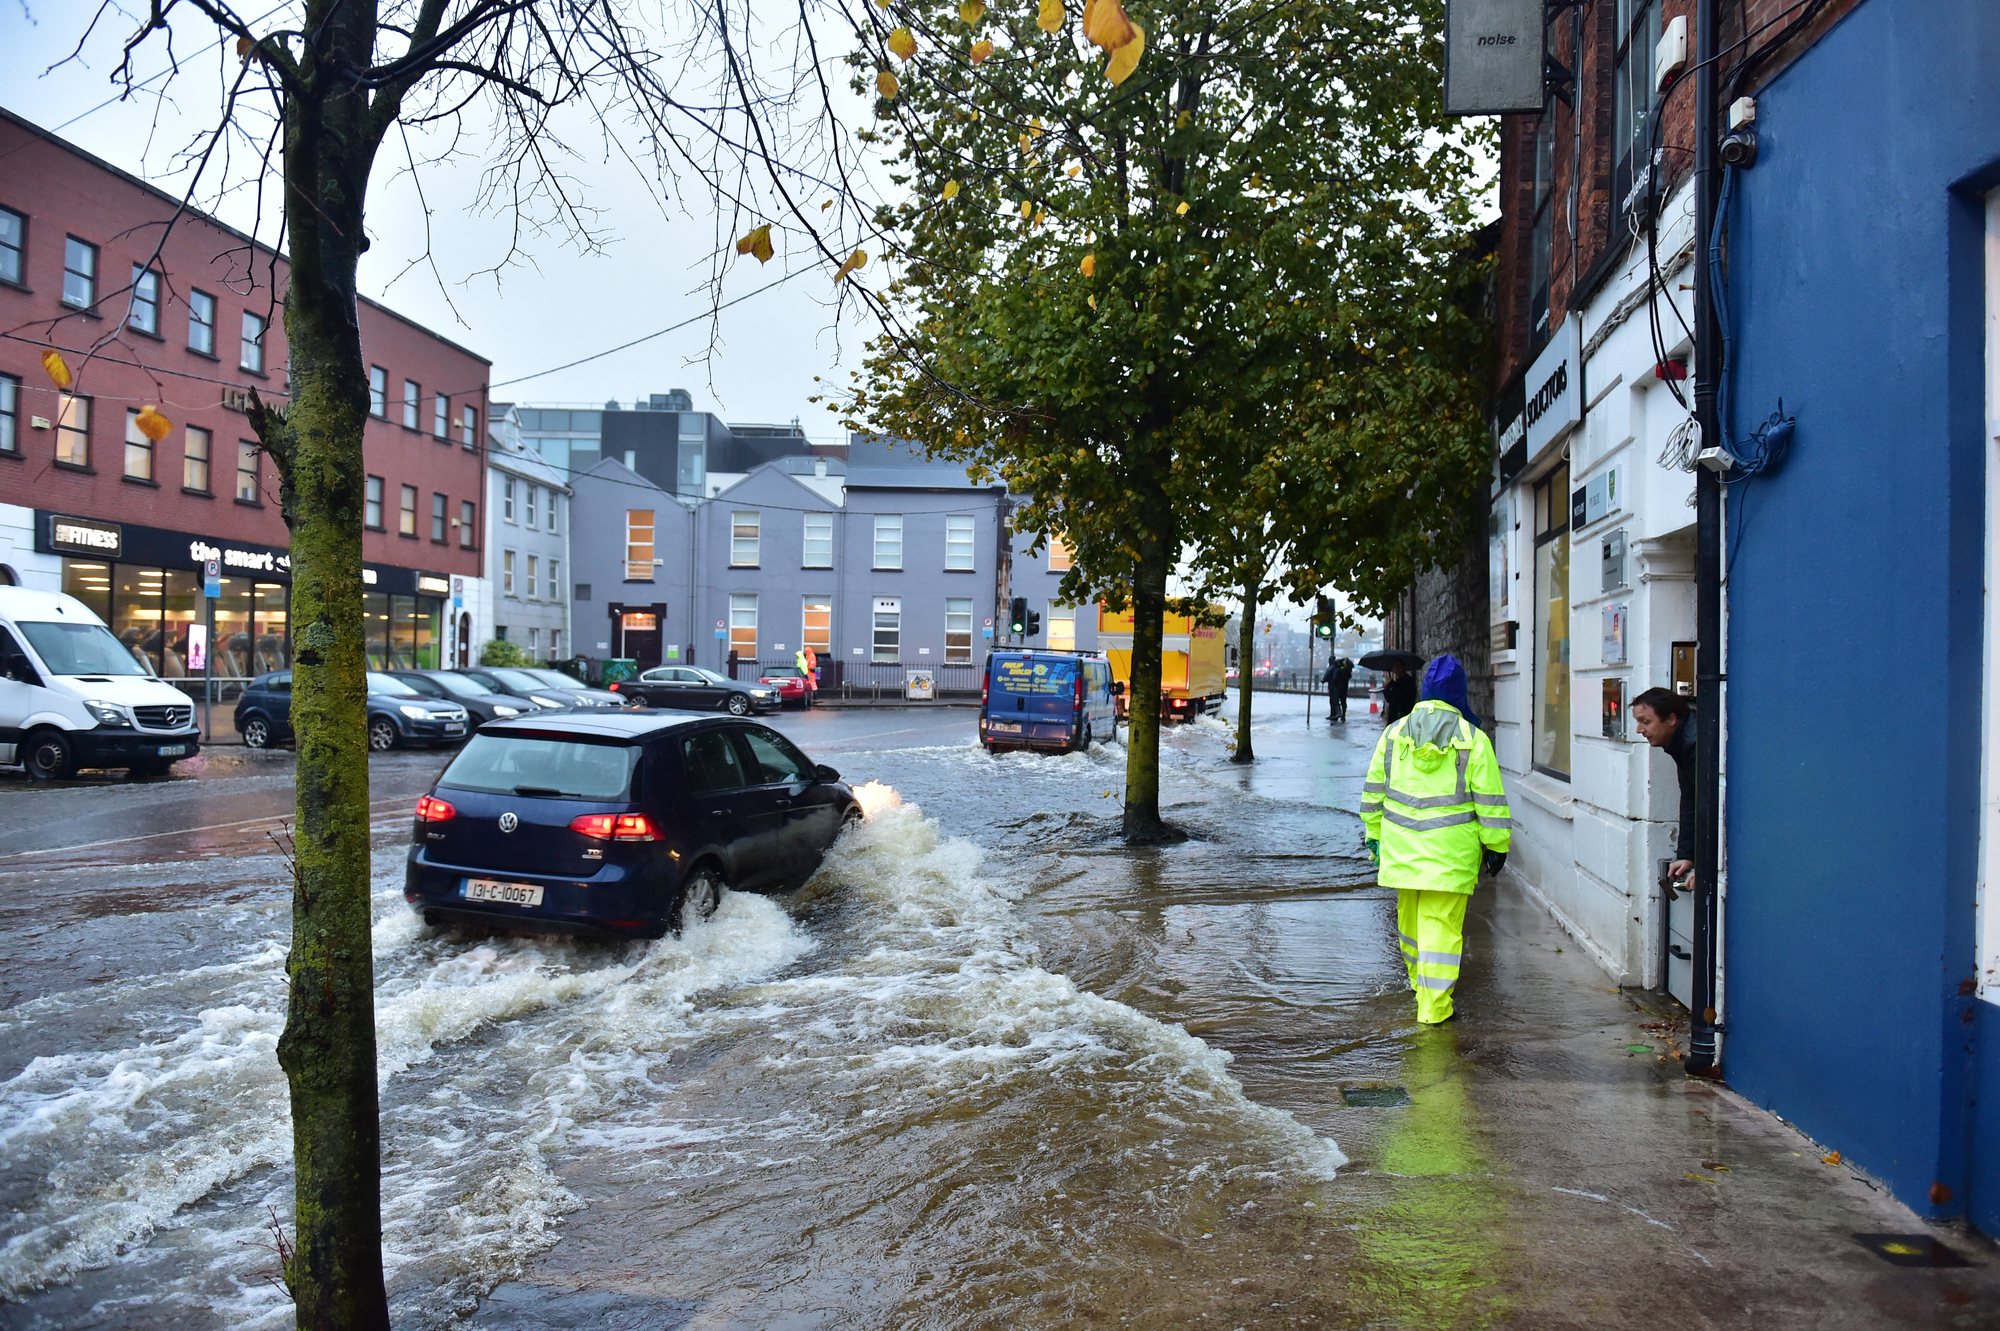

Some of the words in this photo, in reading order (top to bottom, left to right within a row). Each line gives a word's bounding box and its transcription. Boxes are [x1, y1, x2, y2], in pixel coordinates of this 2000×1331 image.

[1478, 33, 1516, 46] noise
[1527, 359, 1567, 428] SOLICITORS
[69, 526, 119, 549] FITNESS
[190, 541, 221, 562] the
[224, 548, 274, 571] smart
[472, 883, 534, 903] 131-C-10067
